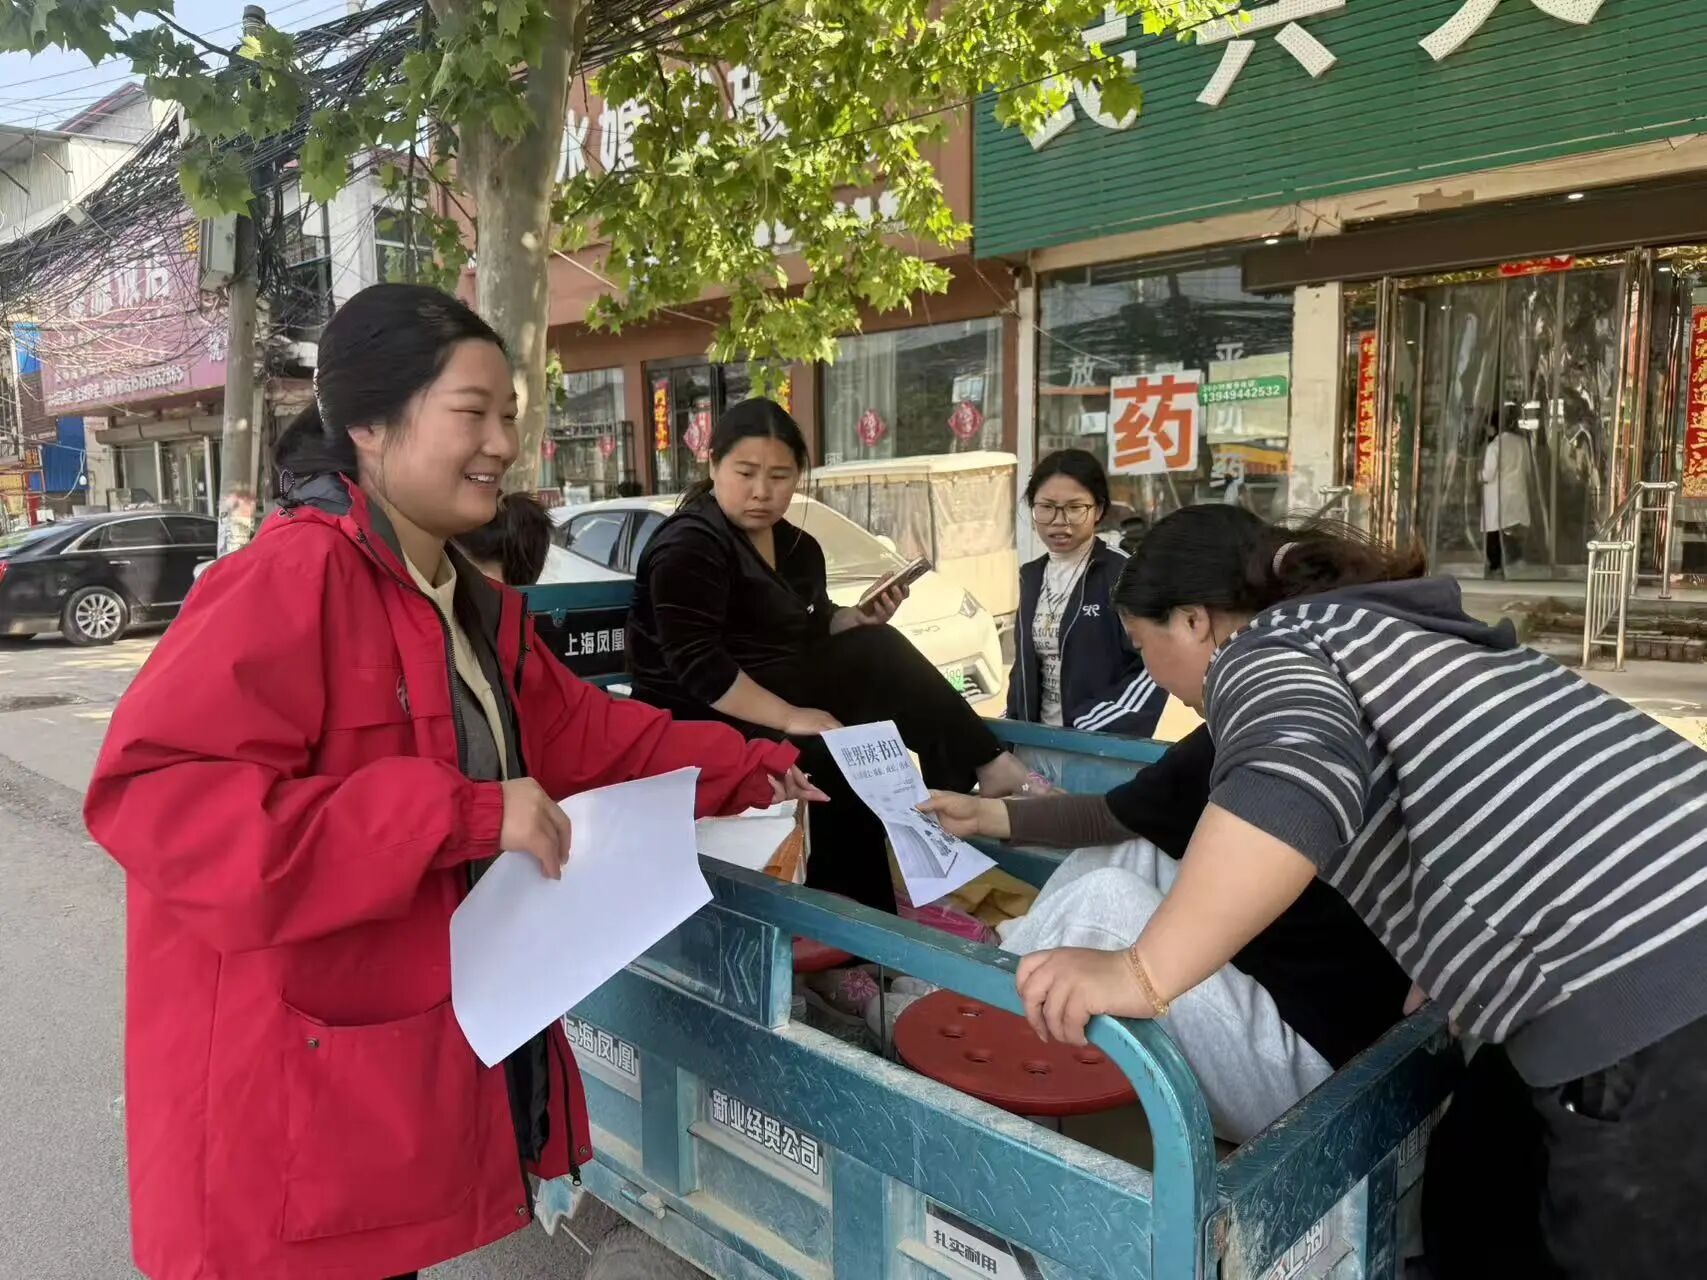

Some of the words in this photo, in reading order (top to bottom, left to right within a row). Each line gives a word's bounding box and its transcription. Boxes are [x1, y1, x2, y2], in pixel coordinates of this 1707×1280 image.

[1113, 374, 1199, 468] 药
[564, 628, 625, 656] 上海凤凰
[841, 739, 903, 767] 世界读书日
[564, 1012, 636, 1076] 上海凤凰
[712, 1088, 819, 1175] 新业经贸公司
[933, 1229, 998, 1274] 扎实耐用
